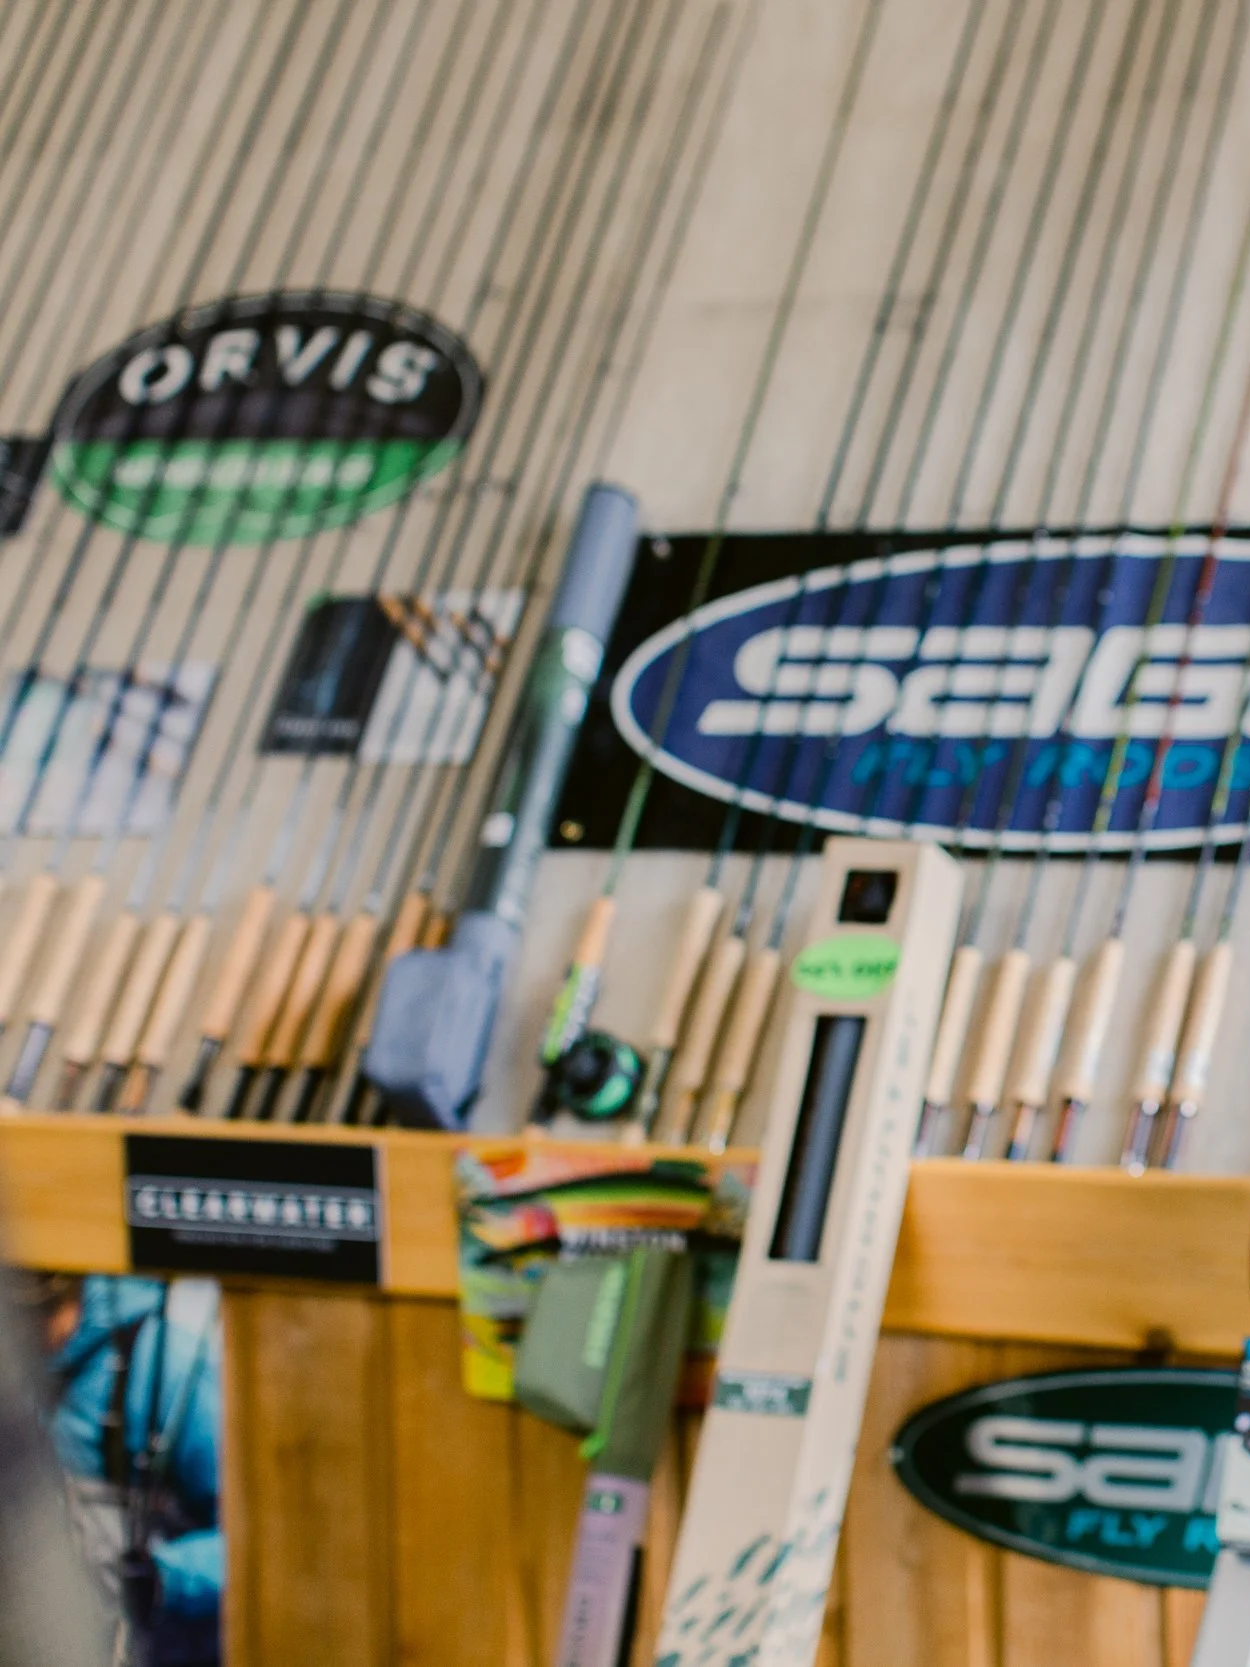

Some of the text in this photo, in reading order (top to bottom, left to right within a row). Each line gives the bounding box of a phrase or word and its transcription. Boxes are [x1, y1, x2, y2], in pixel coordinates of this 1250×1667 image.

[116, 324, 440, 406] ORVIS
[133, 1184, 371, 1231] CLEARWATER
[1063, 1507, 1169, 1548] FLY
